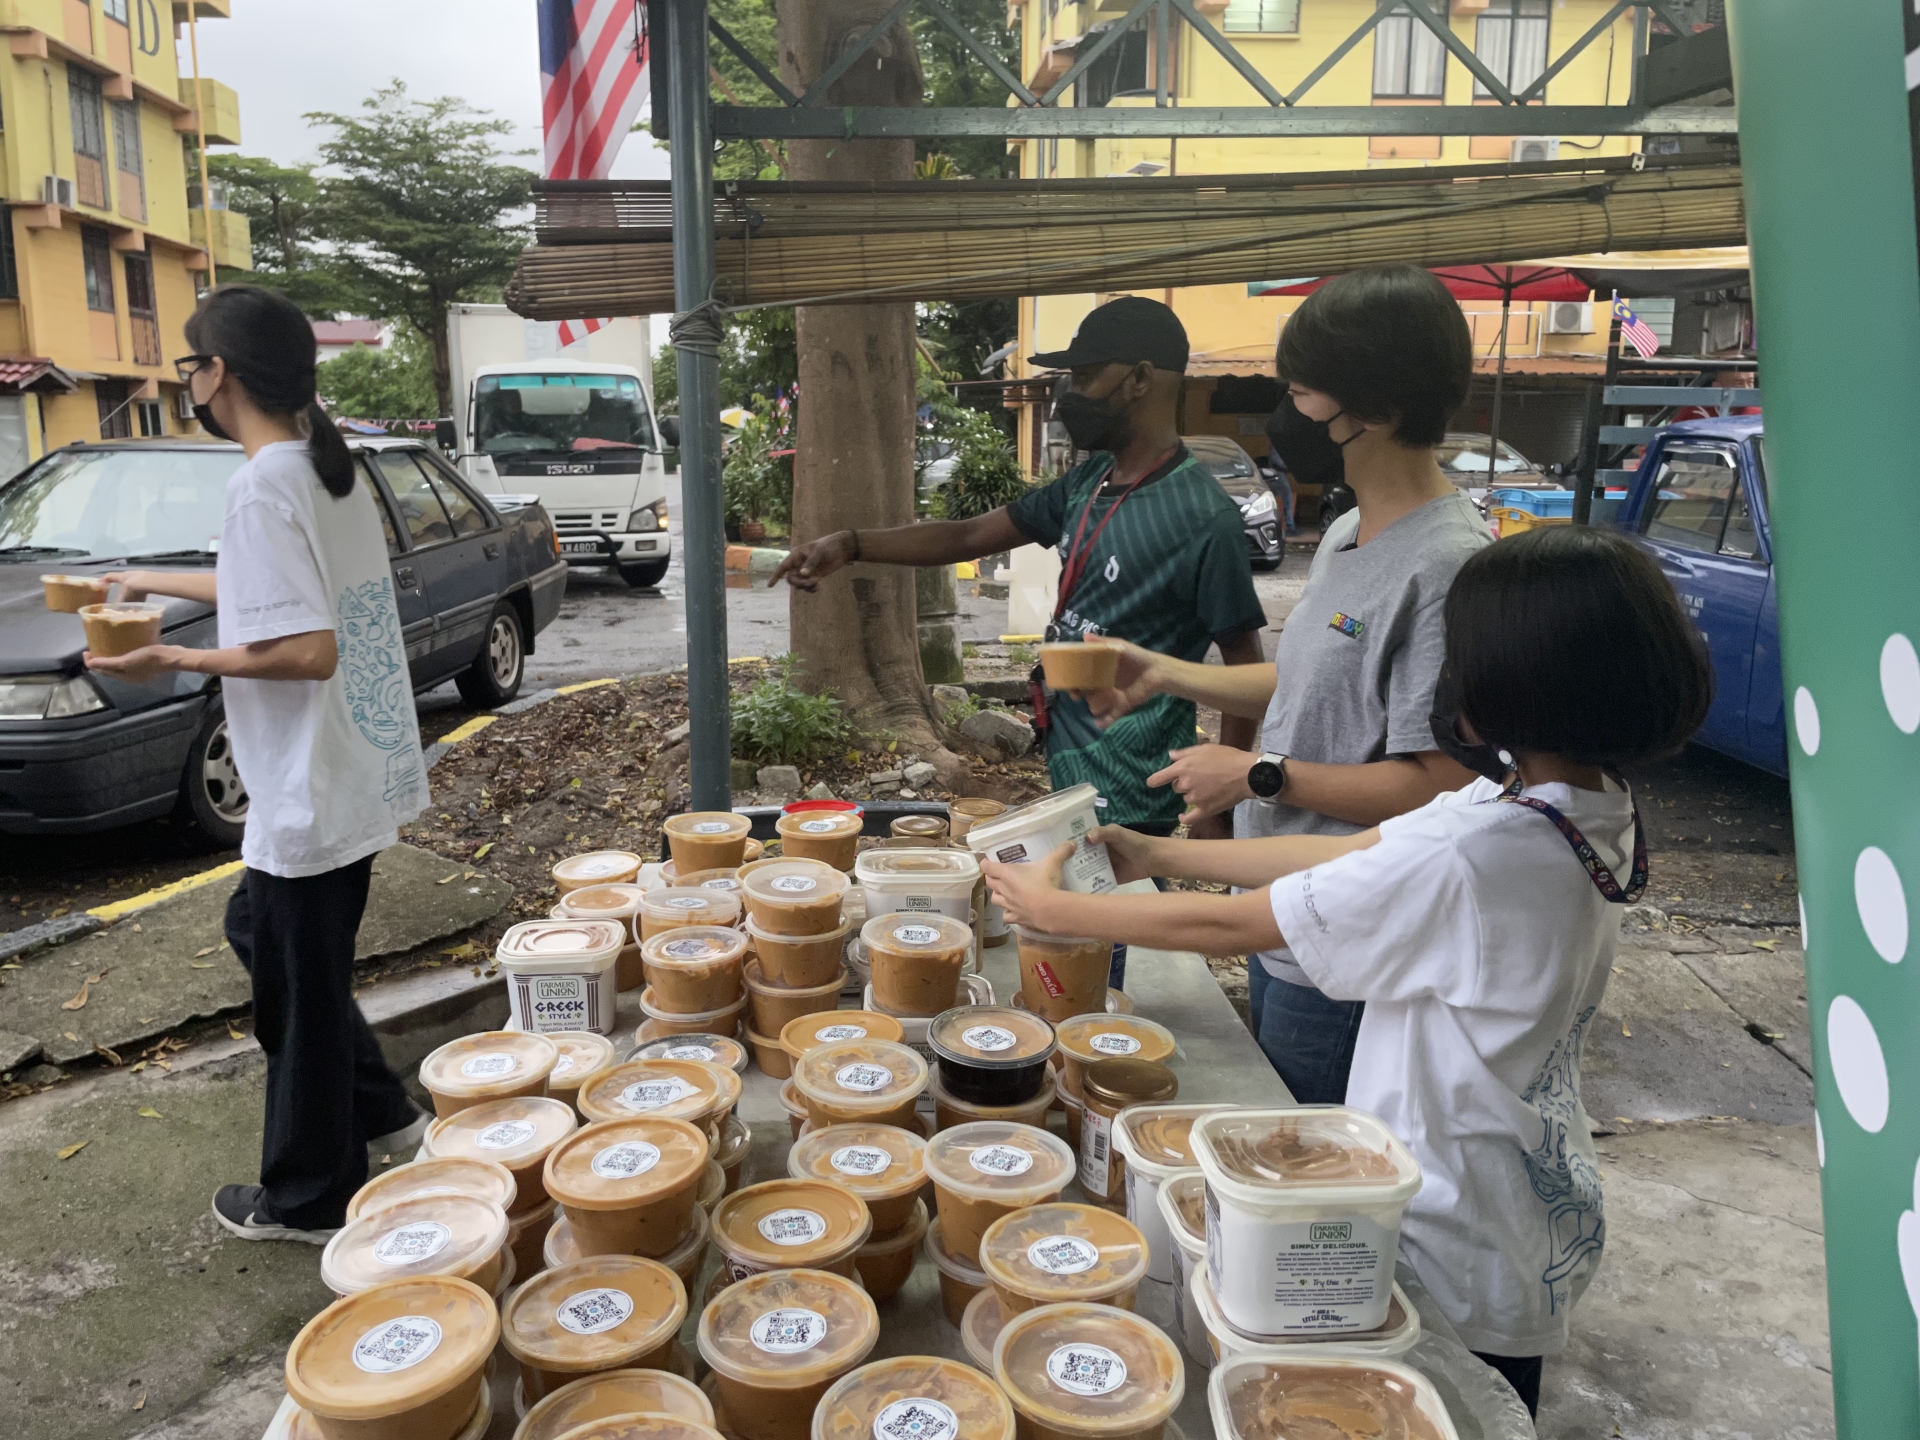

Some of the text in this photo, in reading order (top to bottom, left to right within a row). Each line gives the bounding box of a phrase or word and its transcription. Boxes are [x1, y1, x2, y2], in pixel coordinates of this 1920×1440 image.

[137, 0, 160, 57] D
[546, 464, 595, 475] ISUZU
[573, 542, 597, 553] 4803
[540, 981, 576, 989] FARMERS
[1043, 976, 1062, 998] Jaya
[541, 987, 576, 997] UNION
[535, 1001, 585, 1012] GREEK
[548, 1012, 572, 1020] STYLE
[1314, 1224, 1349, 1232] FARMERS
[1313, 1231, 1348, 1240] UNION
[1322, 1242, 1369, 1250] DELICIOUS.
[1312, 1279, 1325, 1288] Try
[1302, 1314, 1344, 1324] LITTLE CULTURE
